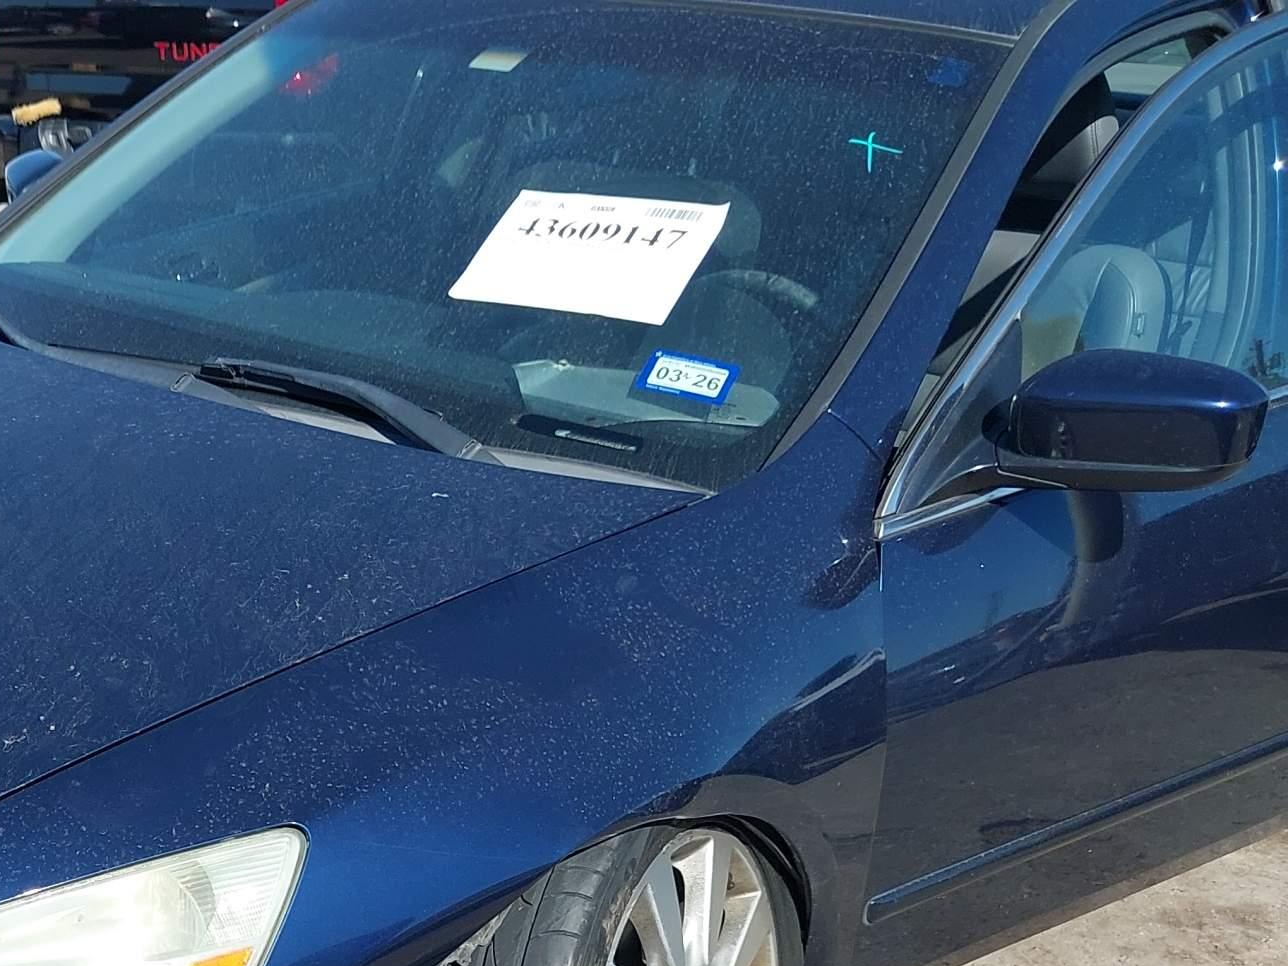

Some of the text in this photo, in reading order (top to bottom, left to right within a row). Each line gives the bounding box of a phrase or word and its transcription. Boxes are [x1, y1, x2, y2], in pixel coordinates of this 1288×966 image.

[518, 217, 689, 249] 43609147
[656, 366, 683, 382] 03
[692, 374, 721, 391] 26
